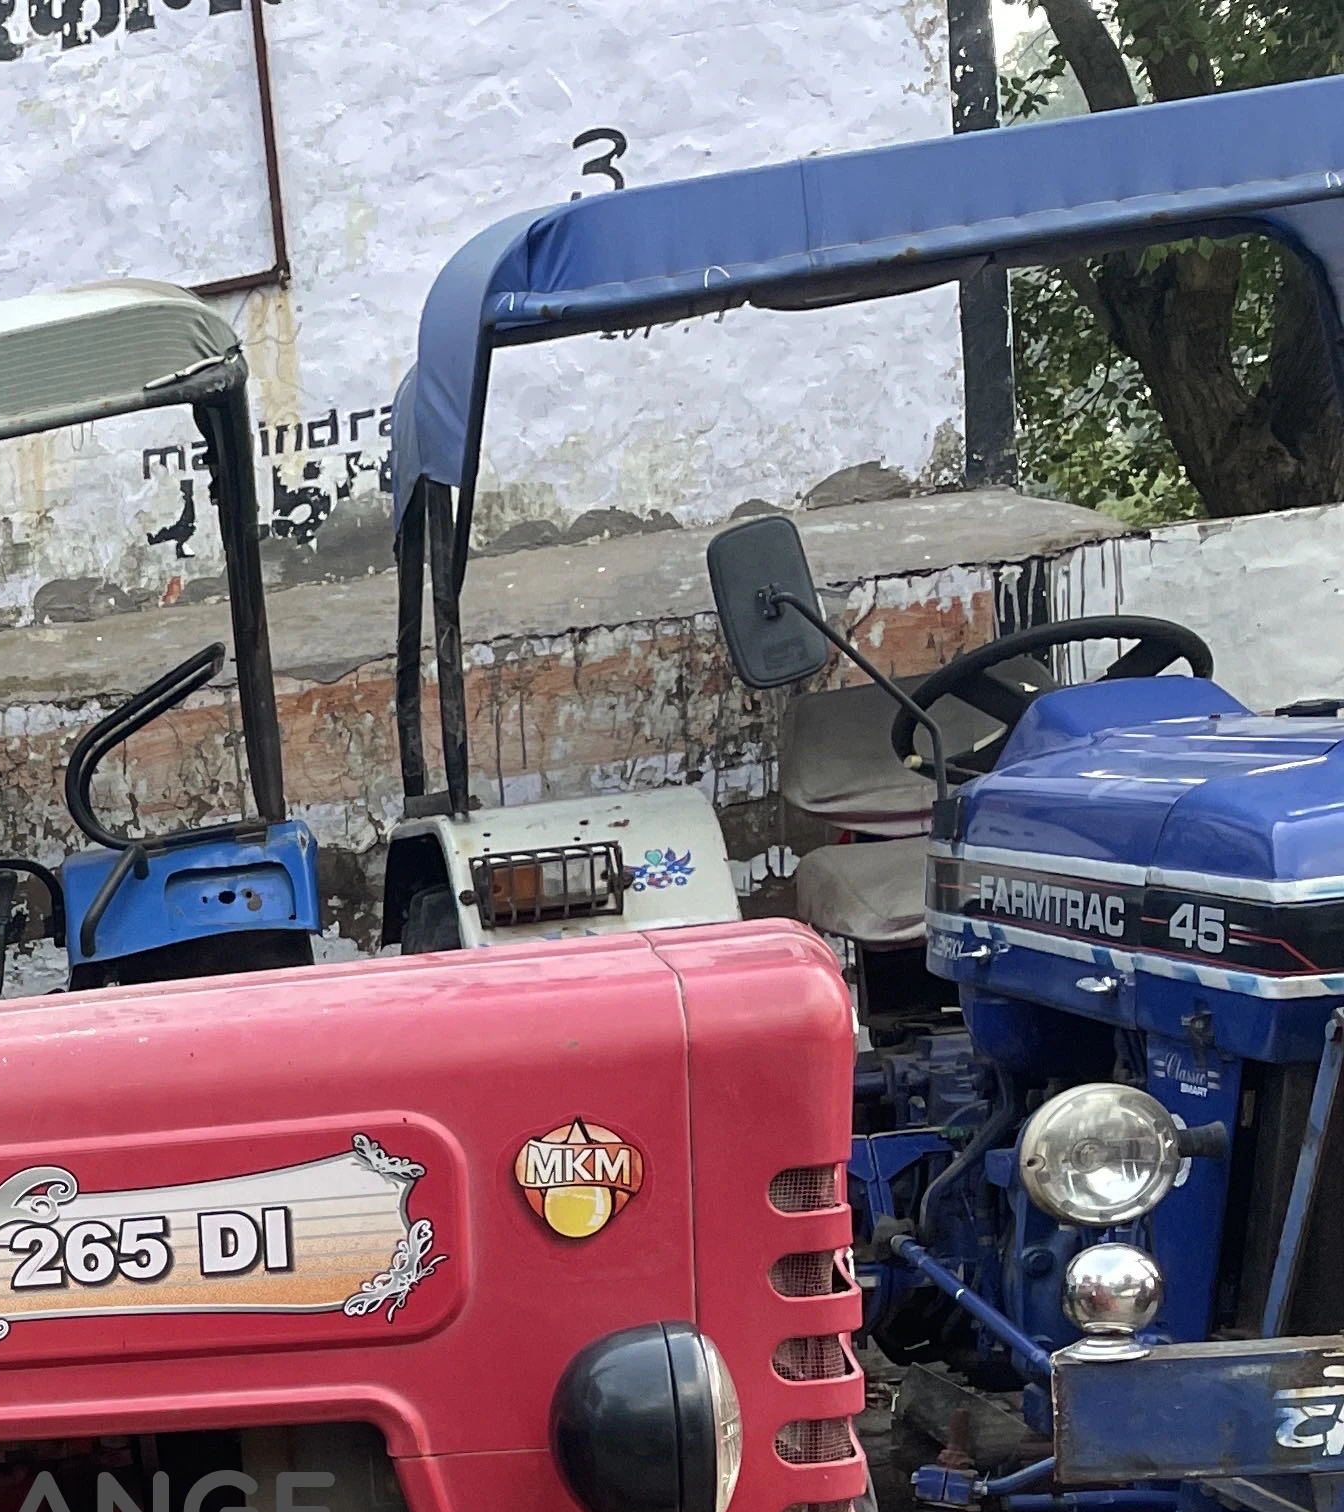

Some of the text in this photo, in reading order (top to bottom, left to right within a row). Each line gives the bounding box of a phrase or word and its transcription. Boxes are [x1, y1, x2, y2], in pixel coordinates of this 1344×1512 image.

[979, 875, 1226, 955] FARMTRAC 45
[525, 1143, 632, 1187] MKM
[8, 1215, 172, 1292] 265
[199, 1204, 293, 1276] DI
